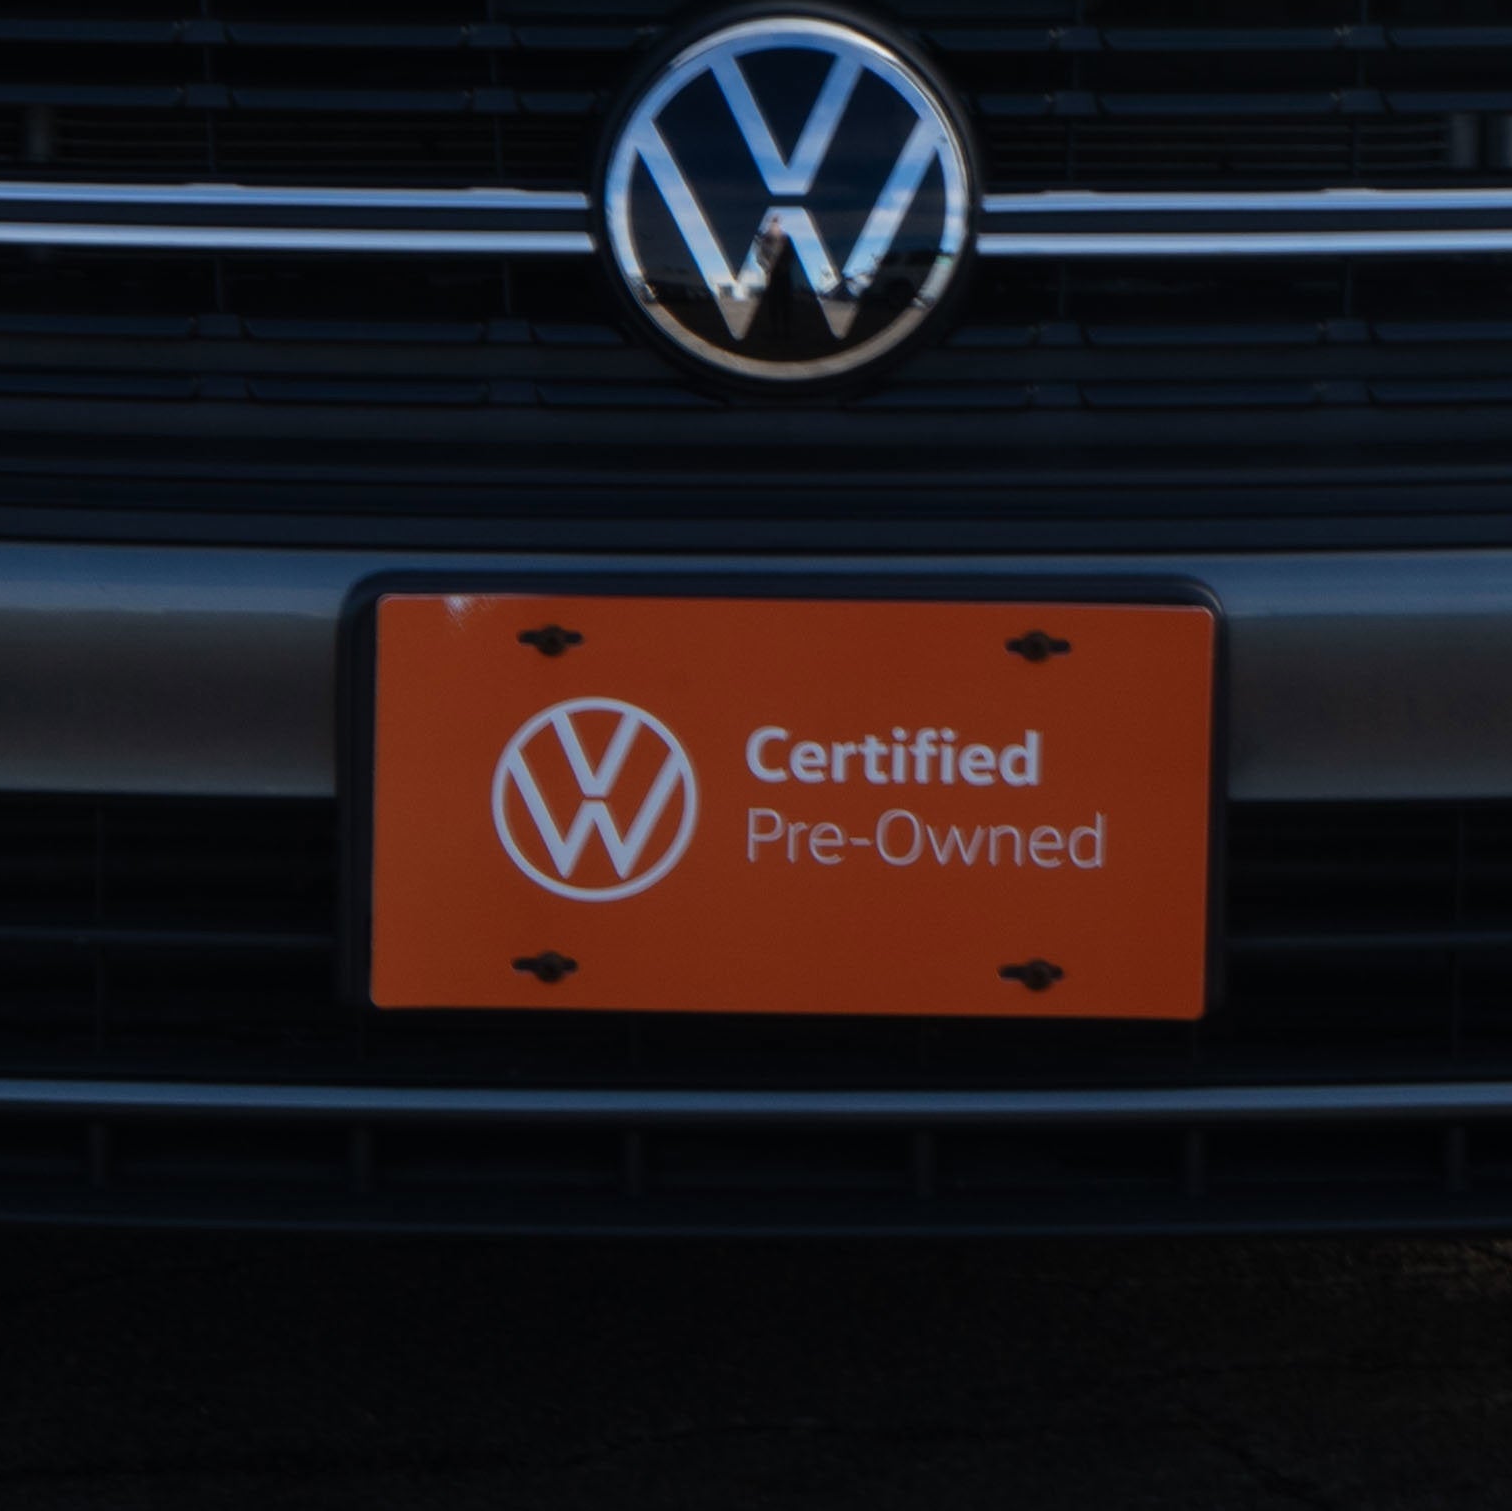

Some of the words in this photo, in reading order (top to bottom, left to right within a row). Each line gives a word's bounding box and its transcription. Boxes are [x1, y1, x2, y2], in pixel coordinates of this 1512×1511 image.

[622, 36, 951, 346] VW
[499, 706, 692, 884] VW
[744, 727, 1042, 787] Certified
[745, 807, 1107, 870] Pre-Owned
